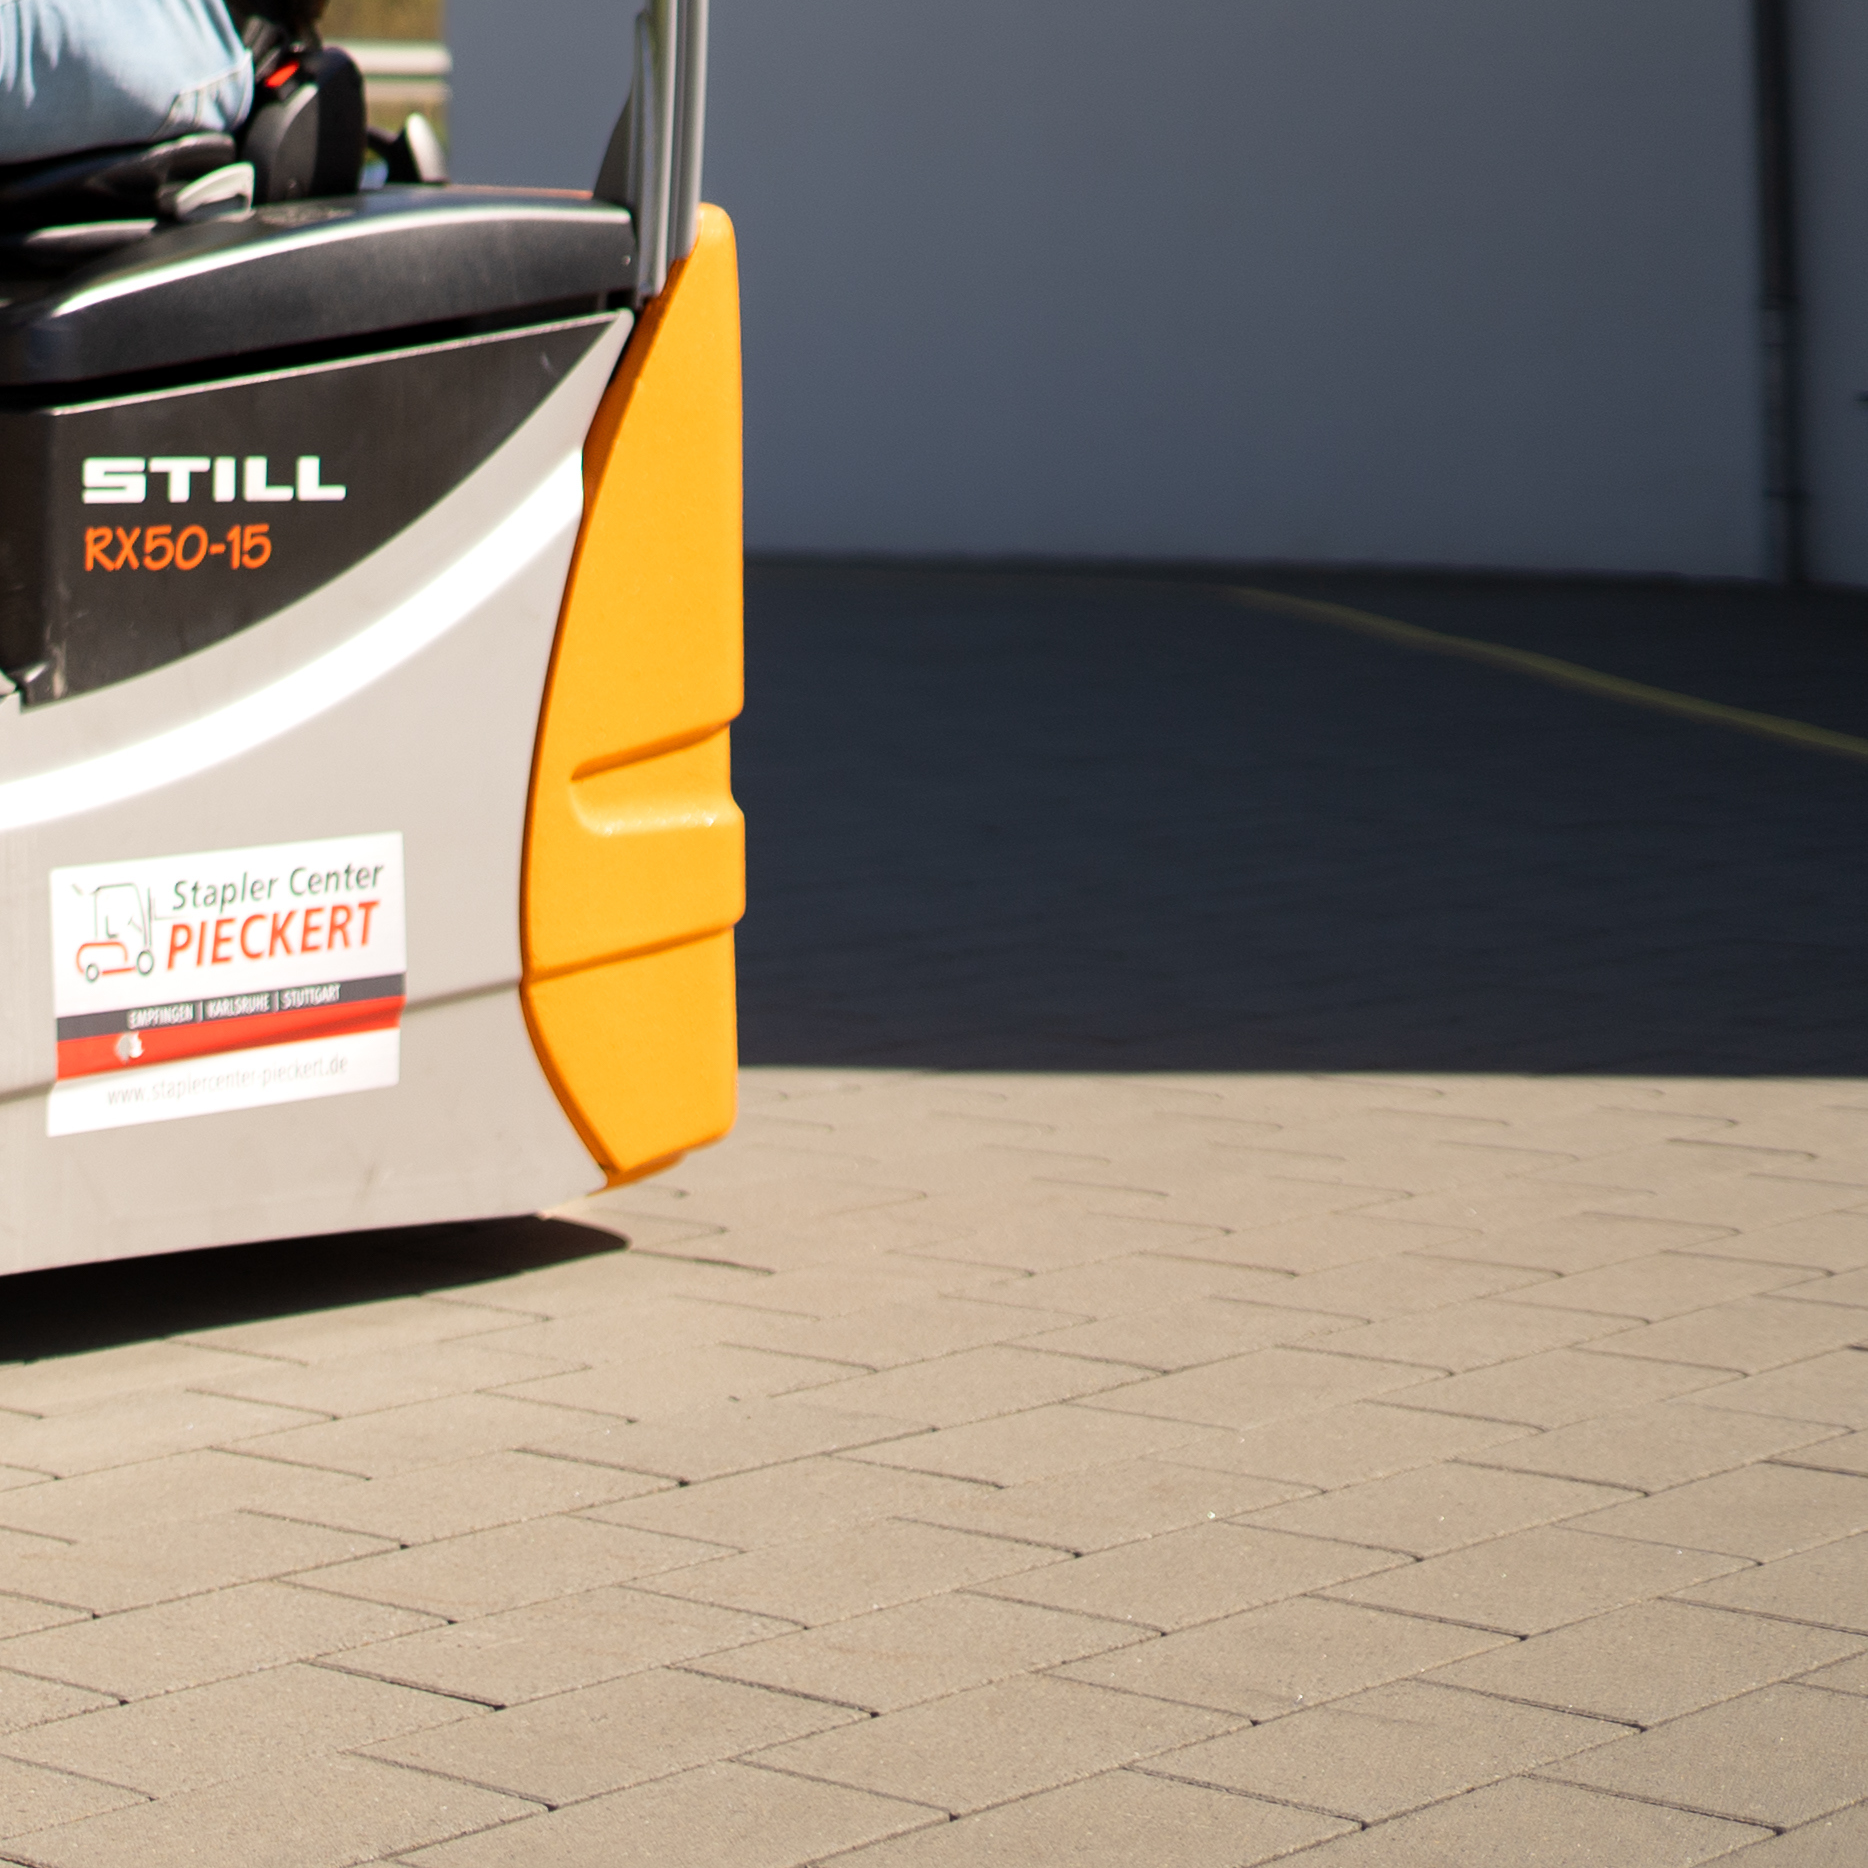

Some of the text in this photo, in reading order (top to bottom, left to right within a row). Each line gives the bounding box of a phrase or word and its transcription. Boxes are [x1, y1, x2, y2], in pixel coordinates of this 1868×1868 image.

[82, 455, 346, 504] STILL
[84, 523, 272, 572] RX50-15
[172, 861, 385, 913] Stapler Center
[166, 899, 381, 972] PIECKERT
[127, 983, 341, 1029] EMPFINGEN KARLSRUHE STUTTGART
[107, 1052, 349, 1105] www.staplercenter-pieckert.de
